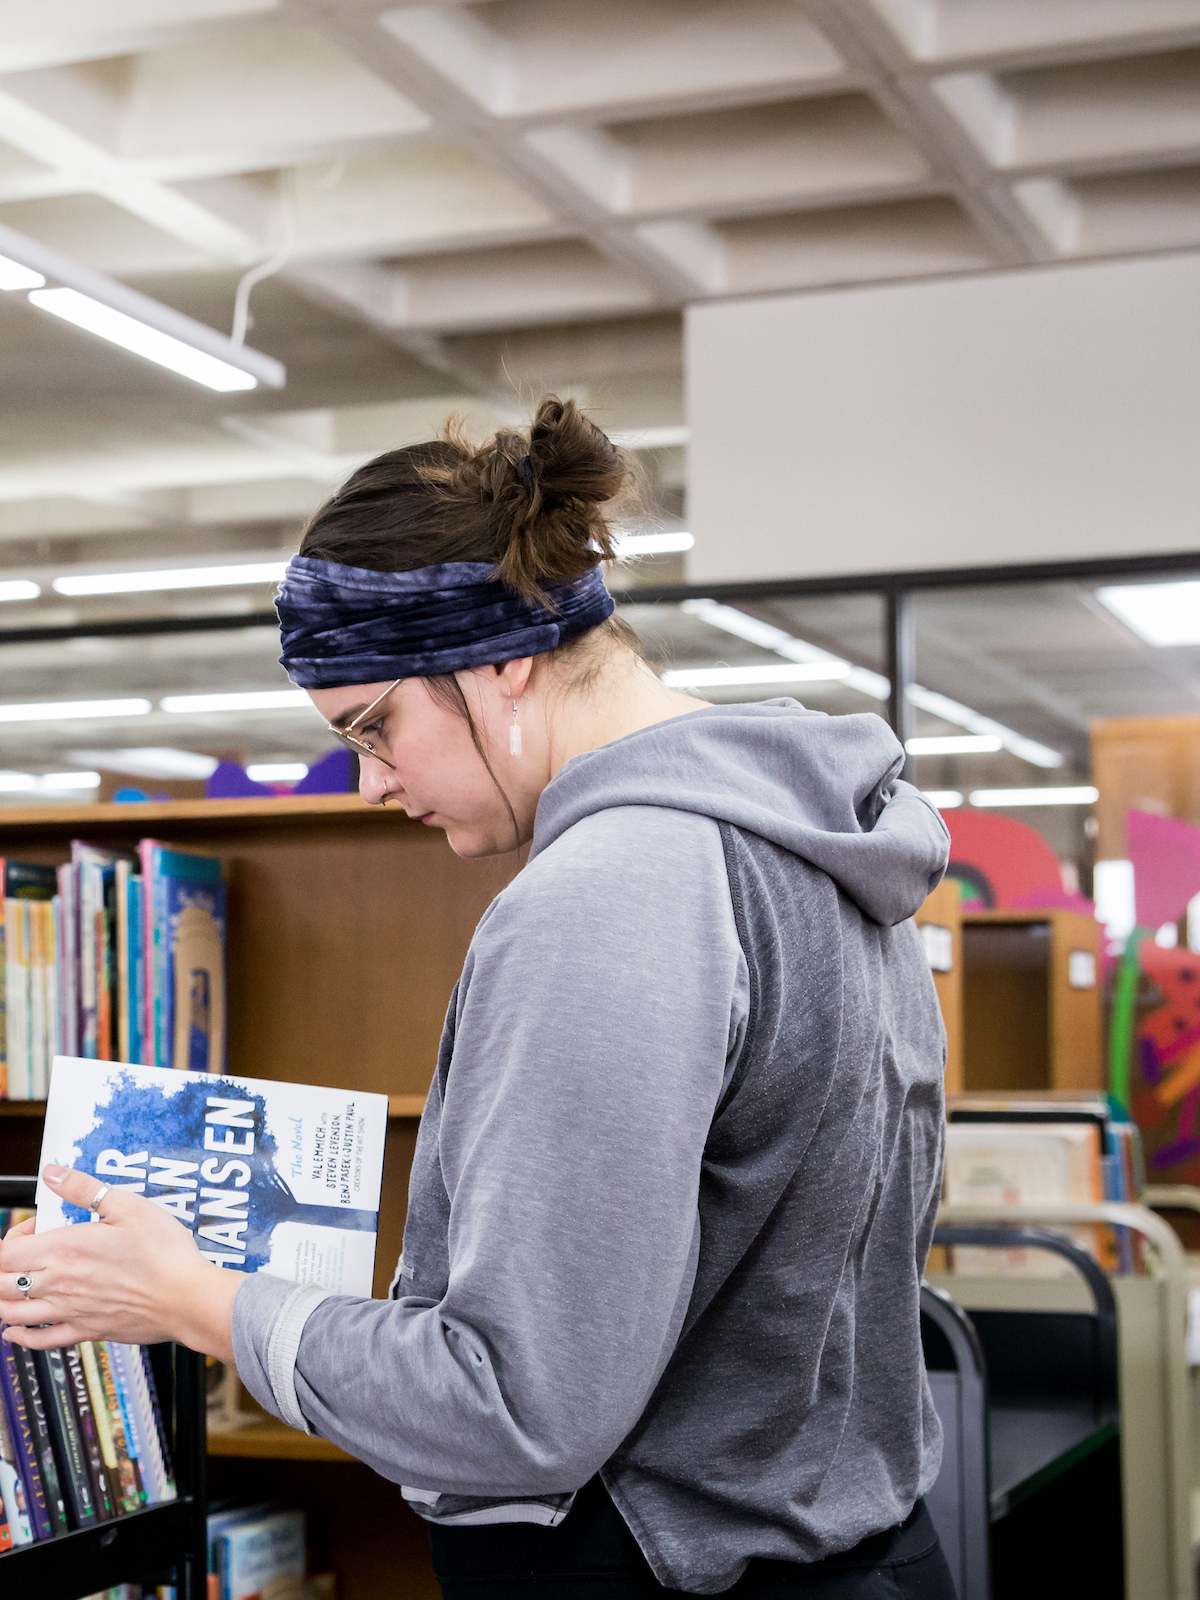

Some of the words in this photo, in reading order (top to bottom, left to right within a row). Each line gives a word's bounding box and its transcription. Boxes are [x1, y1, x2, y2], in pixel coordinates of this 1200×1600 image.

[345, 1102, 355, 1121] PAUL
[288, 1116, 303, 1151] Novel
[313, 1127, 326, 1162] EMMICH
[343, 1124, 354, 1153] JUSTIN
[290, 1154, 303, 1177] The
[312, 1164, 323, 1180] VAL
[326, 1157, 337, 1189] STEVEN
[341, 1158, 352, 1182] PASEK
[354, 1162, 362, 1192] CREATORS
[340, 1183, 351, 1204] BENJ
[25, 1361, 49, 1438] FADE
[6, 1356, 46, 1508] ENCHANTED
